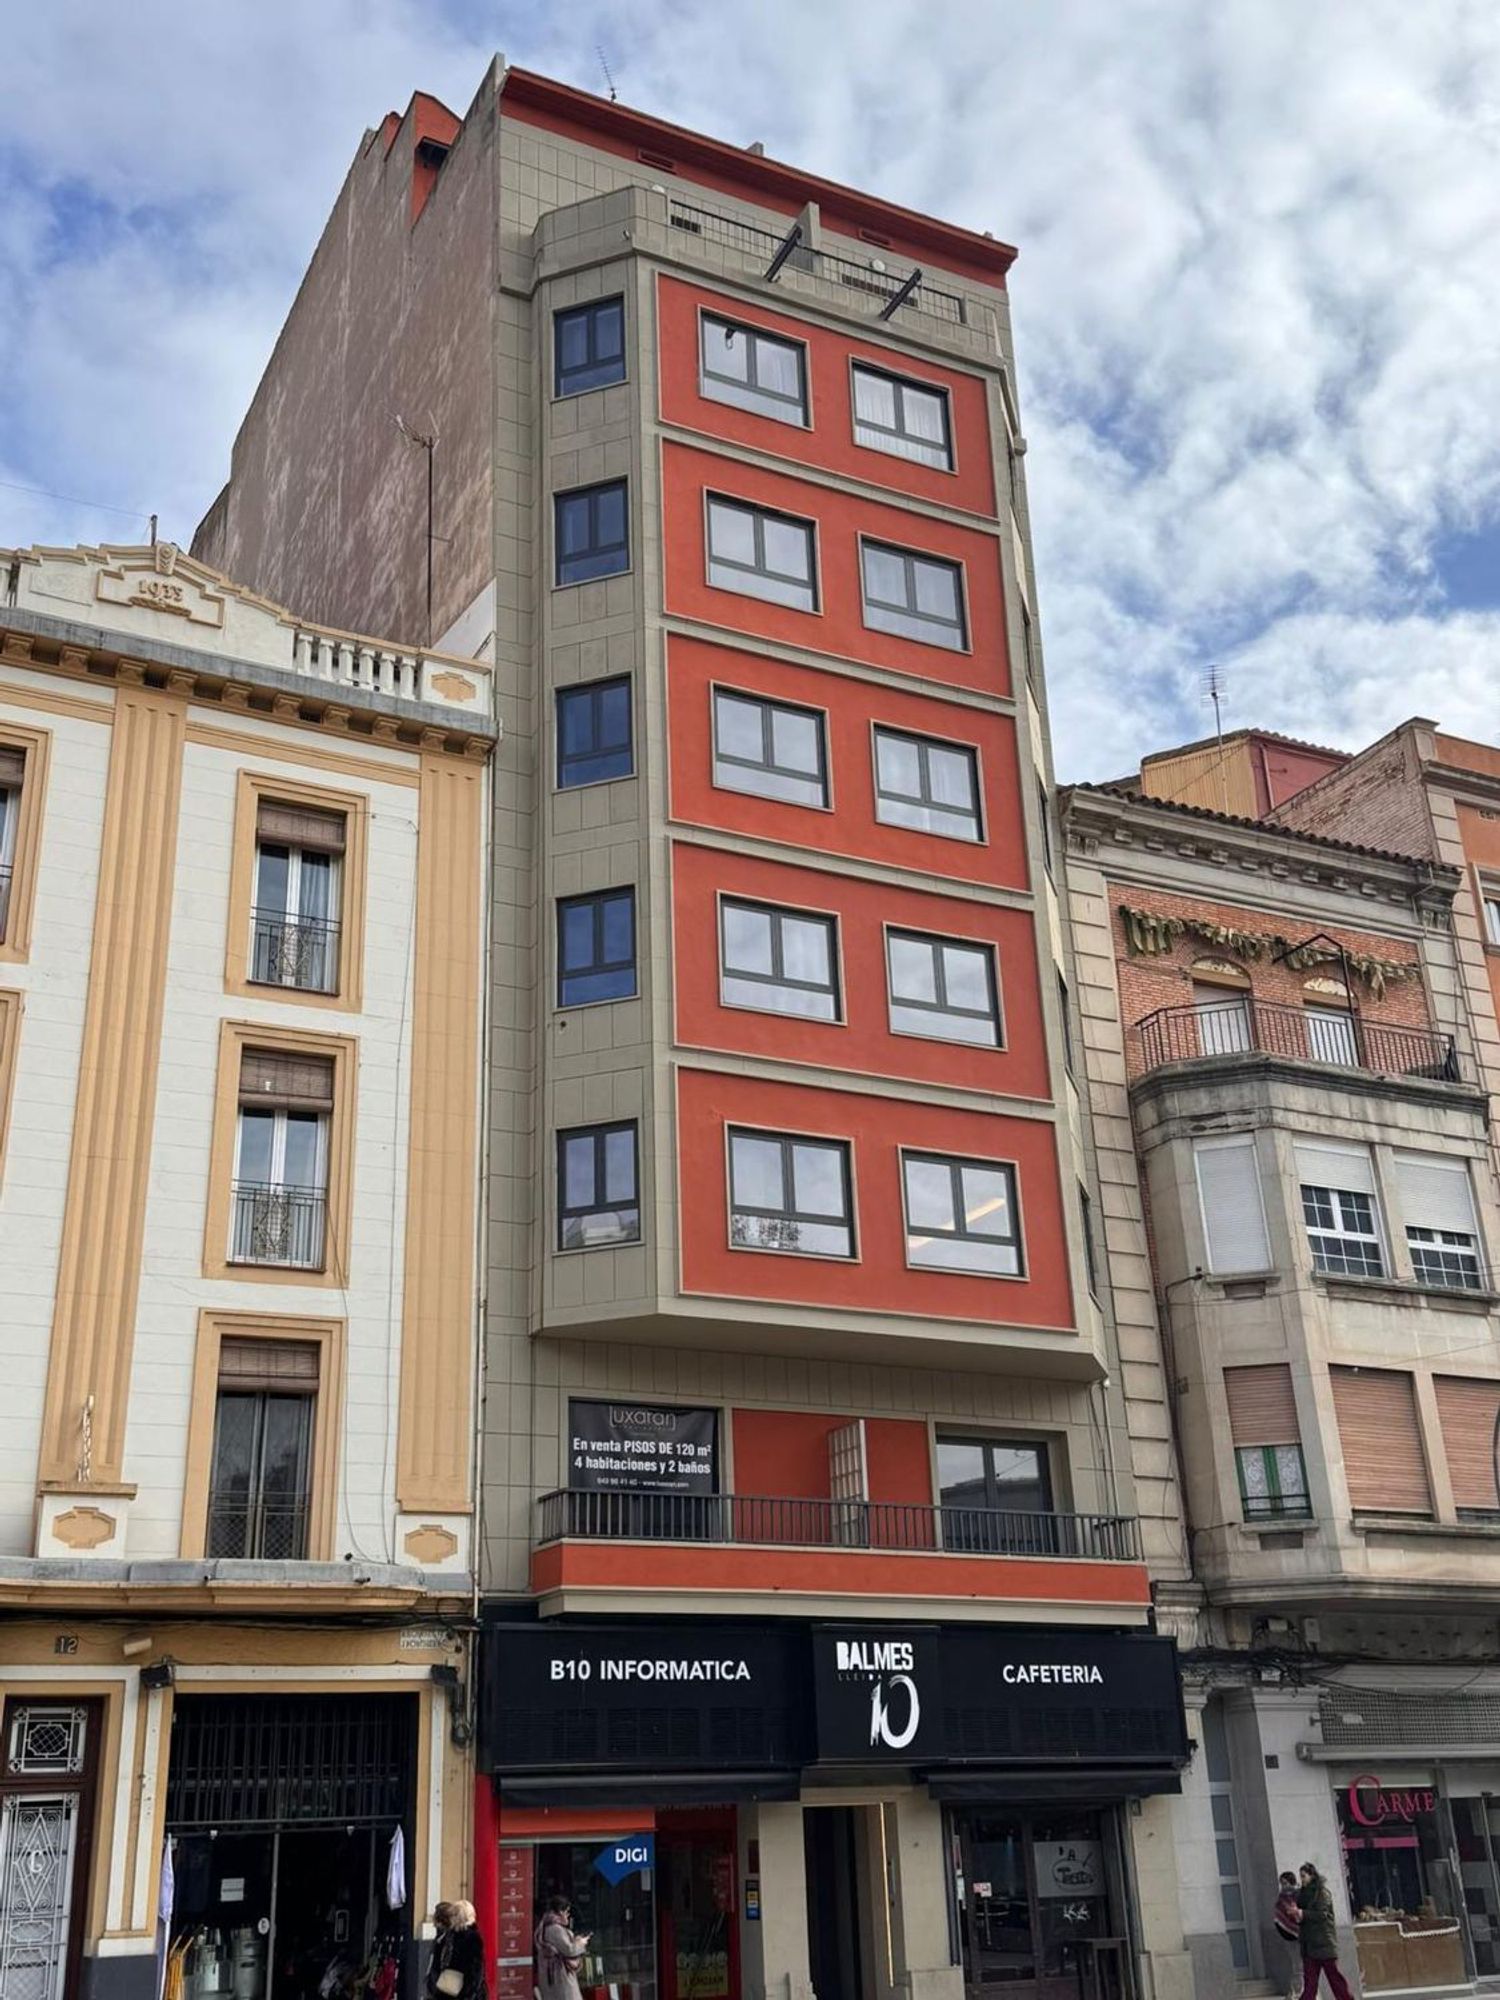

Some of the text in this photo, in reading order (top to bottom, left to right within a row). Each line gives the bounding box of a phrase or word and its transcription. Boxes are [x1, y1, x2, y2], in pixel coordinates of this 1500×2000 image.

[573, 1437, 588, 1451] En
[590, 1440, 621, 1452] venta
[624, 1440, 656, 1454] PISOS
[659, 1442, 673, 1455] DE
[676, 1442, 694, 1456] 120
[574, 1456, 711, 1475] 4 habitaciones y 2 baños
[59, 1637, 78, 1653] 12
[836, 1641, 914, 1670] BALMES
[550, 1660, 751, 1681] B10 INFORMATICA
[1002, 1664, 1104, 1685] CAFETERIA
[870, 1674, 920, 1749] 10
[1349, 1774, 1437, 1826] CARME
[615, 1847, 648, 1864] DIGI
